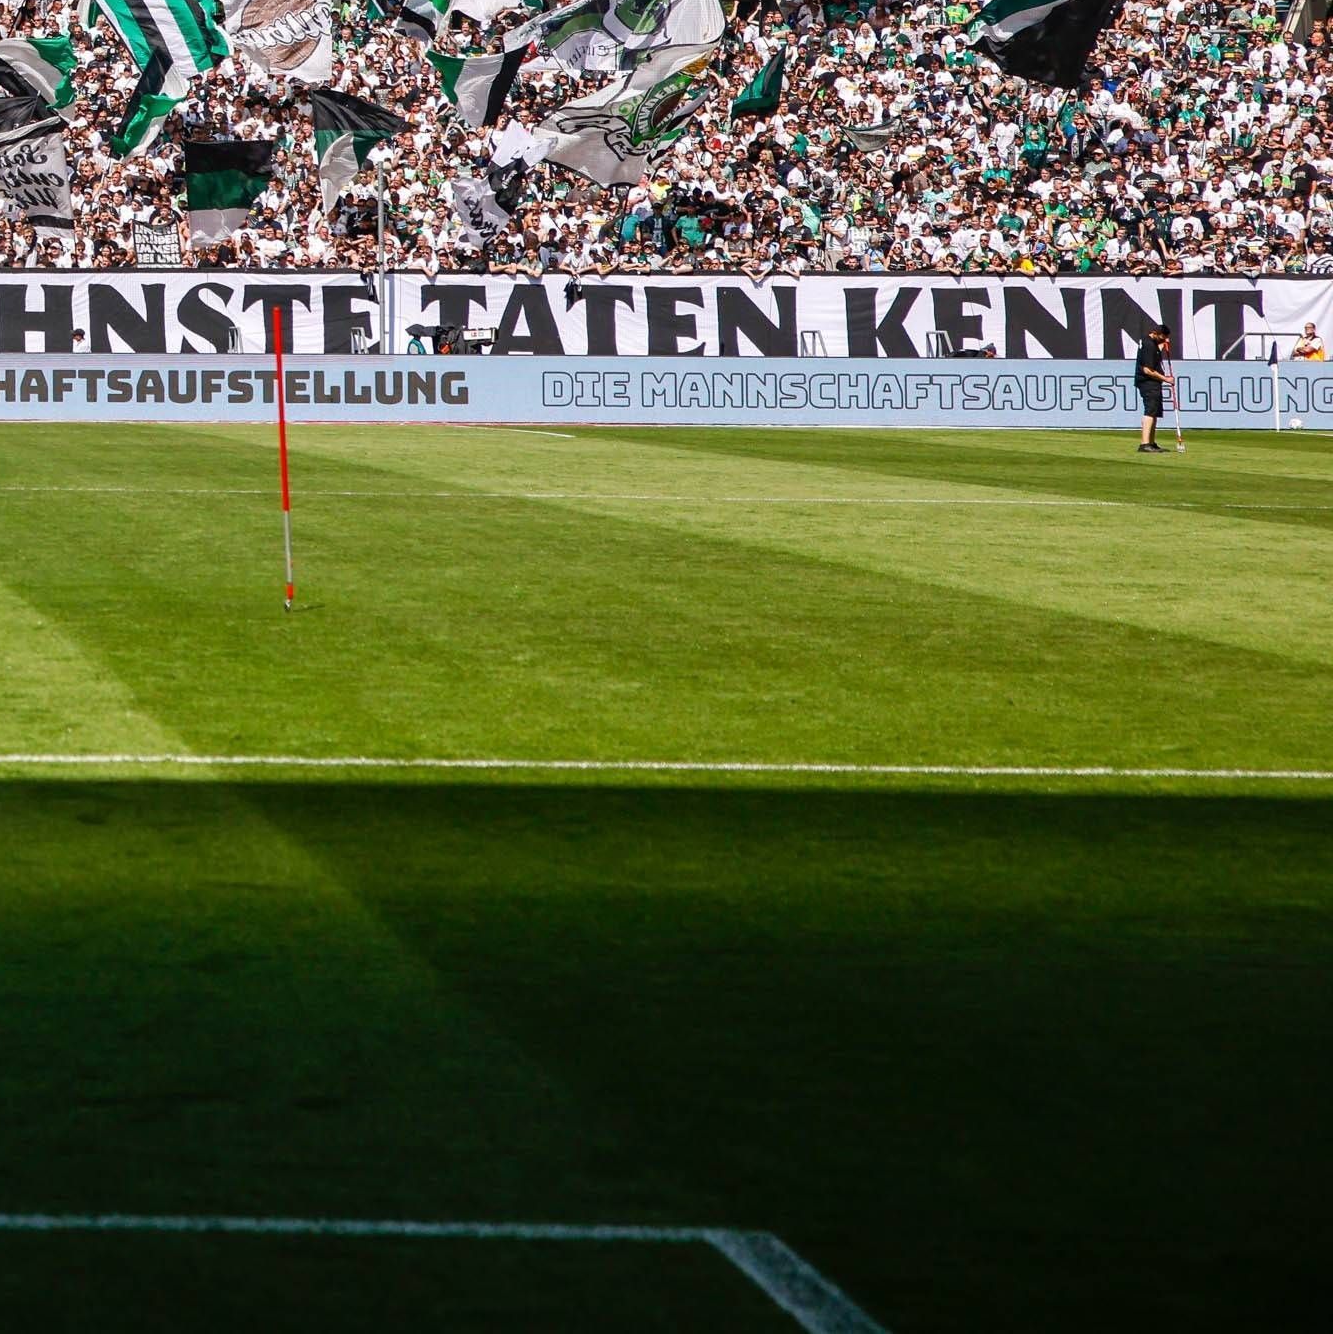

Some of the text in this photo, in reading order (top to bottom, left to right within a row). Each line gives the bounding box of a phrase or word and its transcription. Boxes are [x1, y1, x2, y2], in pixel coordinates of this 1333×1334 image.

[420, 283, 799, 357] TATEN
[843, 284, 1265, 360] KENNT
[542, 371, 631, 408] DIE
